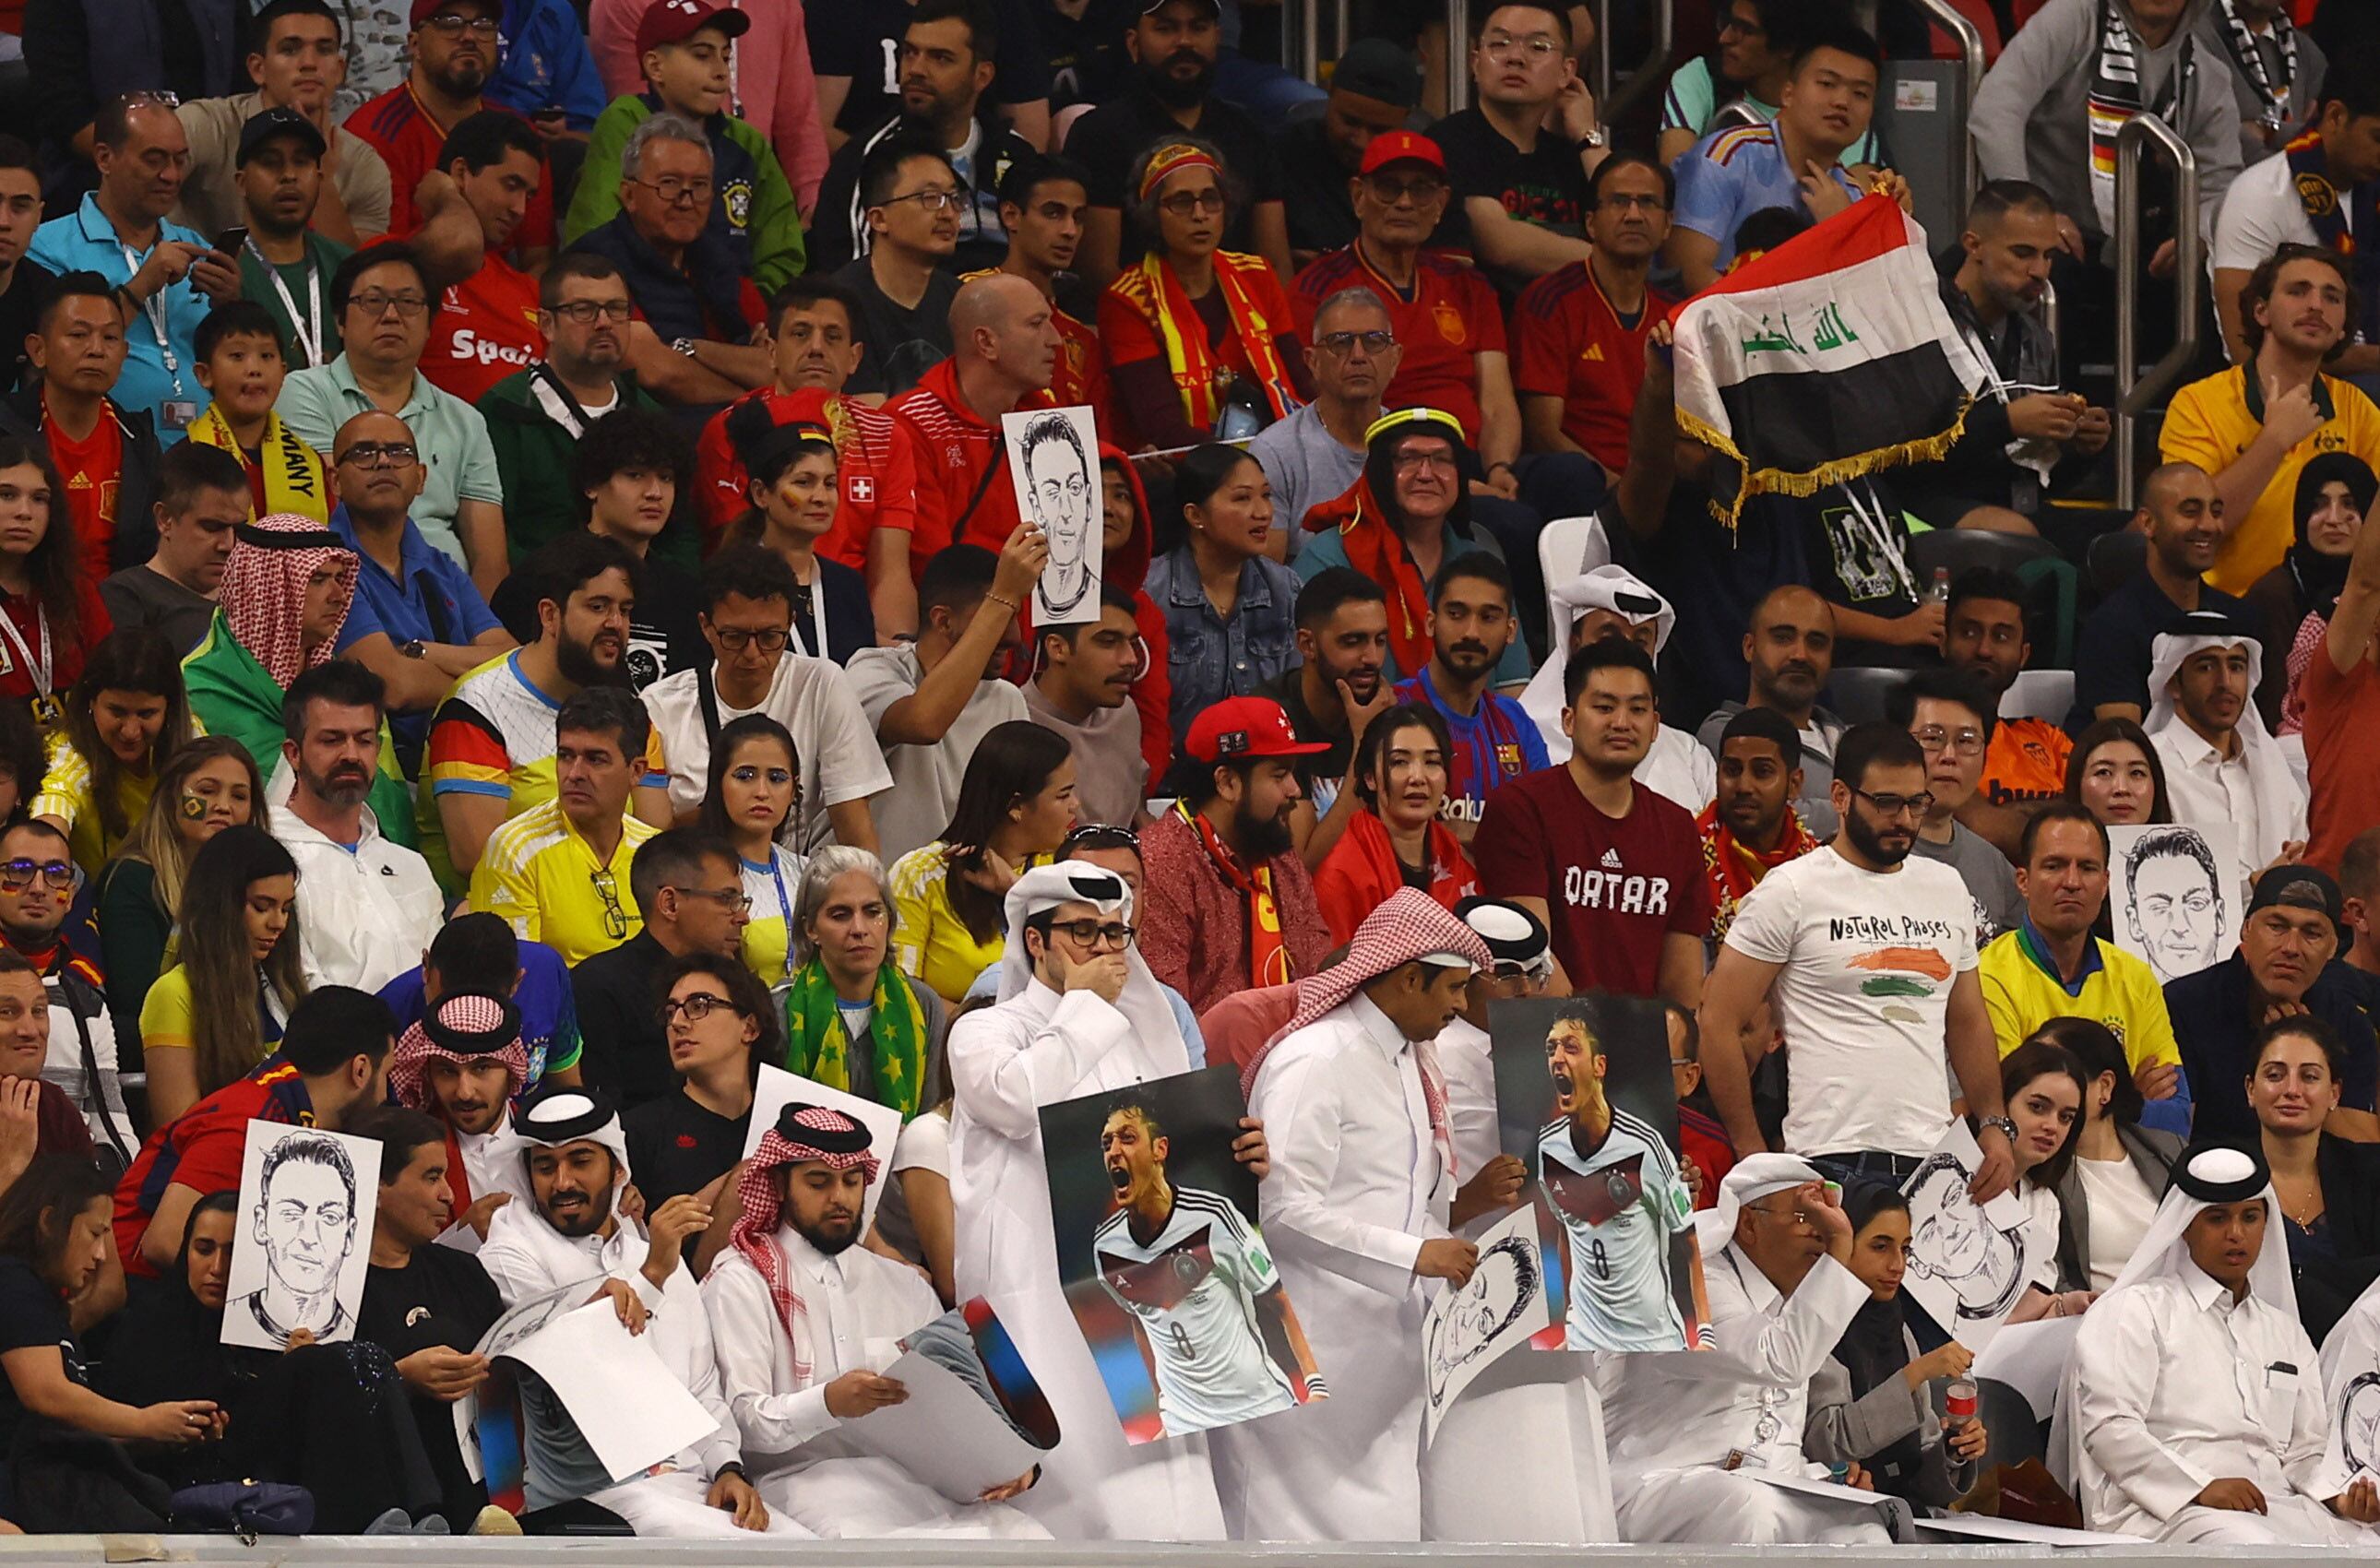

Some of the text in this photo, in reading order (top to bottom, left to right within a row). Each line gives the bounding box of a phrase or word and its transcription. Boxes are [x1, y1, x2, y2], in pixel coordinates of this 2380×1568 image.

[1438, 791, 1486, 823] Raku
[1565, 865, 1670, 916] QATAR
[1591, 1238, 1610, 1281] 8
[1170, 1320, 1196, 1361] 8
